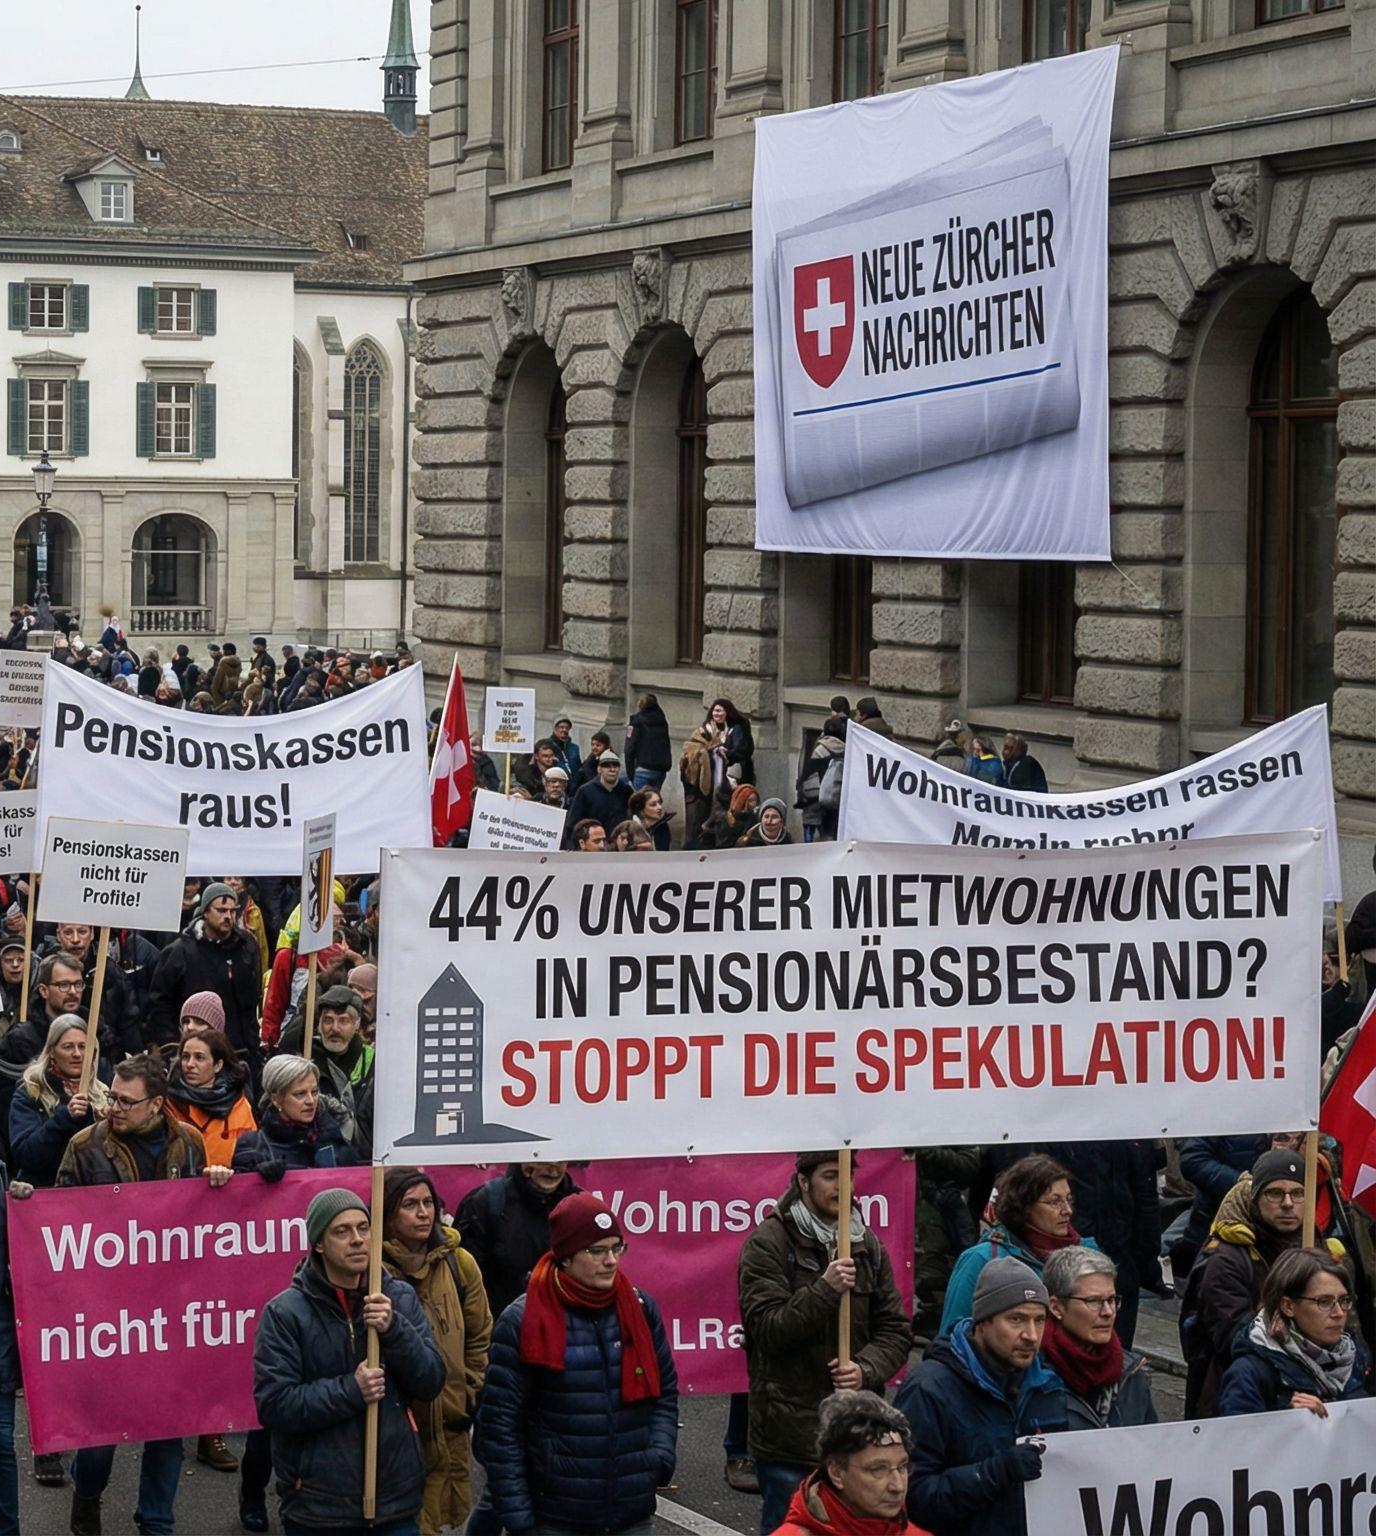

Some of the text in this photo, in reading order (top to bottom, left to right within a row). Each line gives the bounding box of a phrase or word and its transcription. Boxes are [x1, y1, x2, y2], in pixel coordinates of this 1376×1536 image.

[862, 208, 1056, 307] NEUE ZÜRCHER
[862, 285, 1045, 376] NACHRICHTEN
[54, 702, 411, 771] Pensionskassen
[179, 783, 292, 828] raus!
[1179, 750, 1303, 802] rassen
[4, 825, 22, 838] für
[53, 837, 180, 863] Pensionskassen
[80, 864, 148, 884] nicht für
[83, 887, 141, 907] Profite!
[429, 864, 1290, 942] 44% UNSERER MIETWOHNUNGEN
[535, 935, 1268, 1019] IN PENSIONÄRSBESTAND?
[500, 1016, 1286, 1107] STOPPT DIE SPEKULATION!
[41, 1300, 256, 1362] nicht für
[1079, 1468, 1376, 1536] Wohnr
